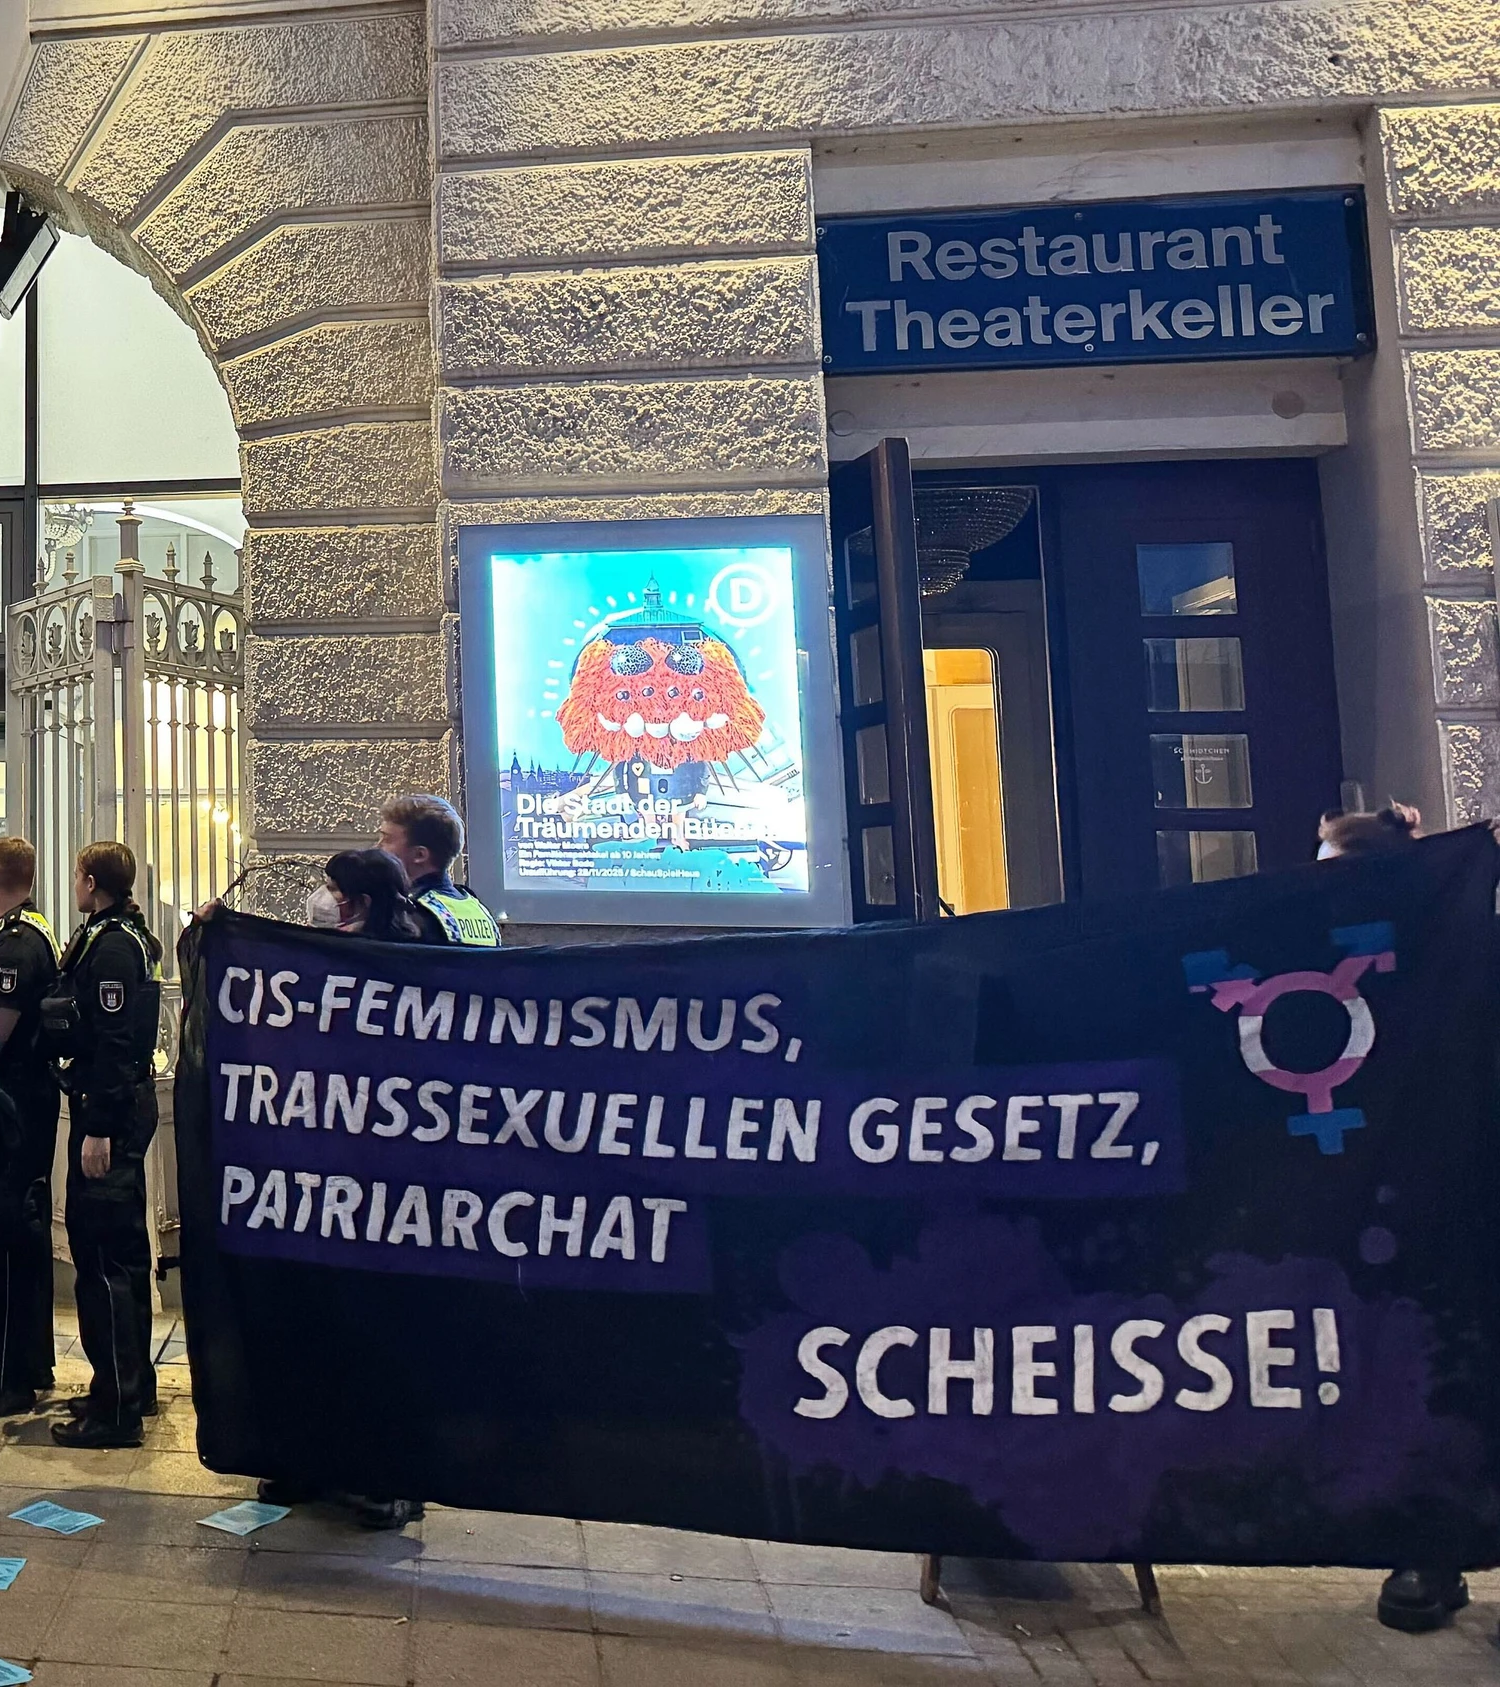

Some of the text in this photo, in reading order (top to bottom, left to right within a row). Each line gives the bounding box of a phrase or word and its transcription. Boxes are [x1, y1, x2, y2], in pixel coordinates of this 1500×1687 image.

[887, 214, 1286, 283] Restaurant
[845, 284, 1335, 352] Theaterkeller
[1173, 746, 1230, 754] SCMIDTCHEN
[516, 793, 682, 818] Die Stadt der
[518, 817, 678, 839] Träumenden
[622, 851, 631, 859] 10
[457, 917, 494, 940] POLIZEI
[218, 966, 803, 1063] CIS-FEMINISMUS,
[219, 1062, 1160, 1167] TRANSSEXUELLEN GESETZ,
[219, 1164, 689, 1264] PATRIARCHAT
[792, 1307, 1342, 1420] SCHEISSE!
